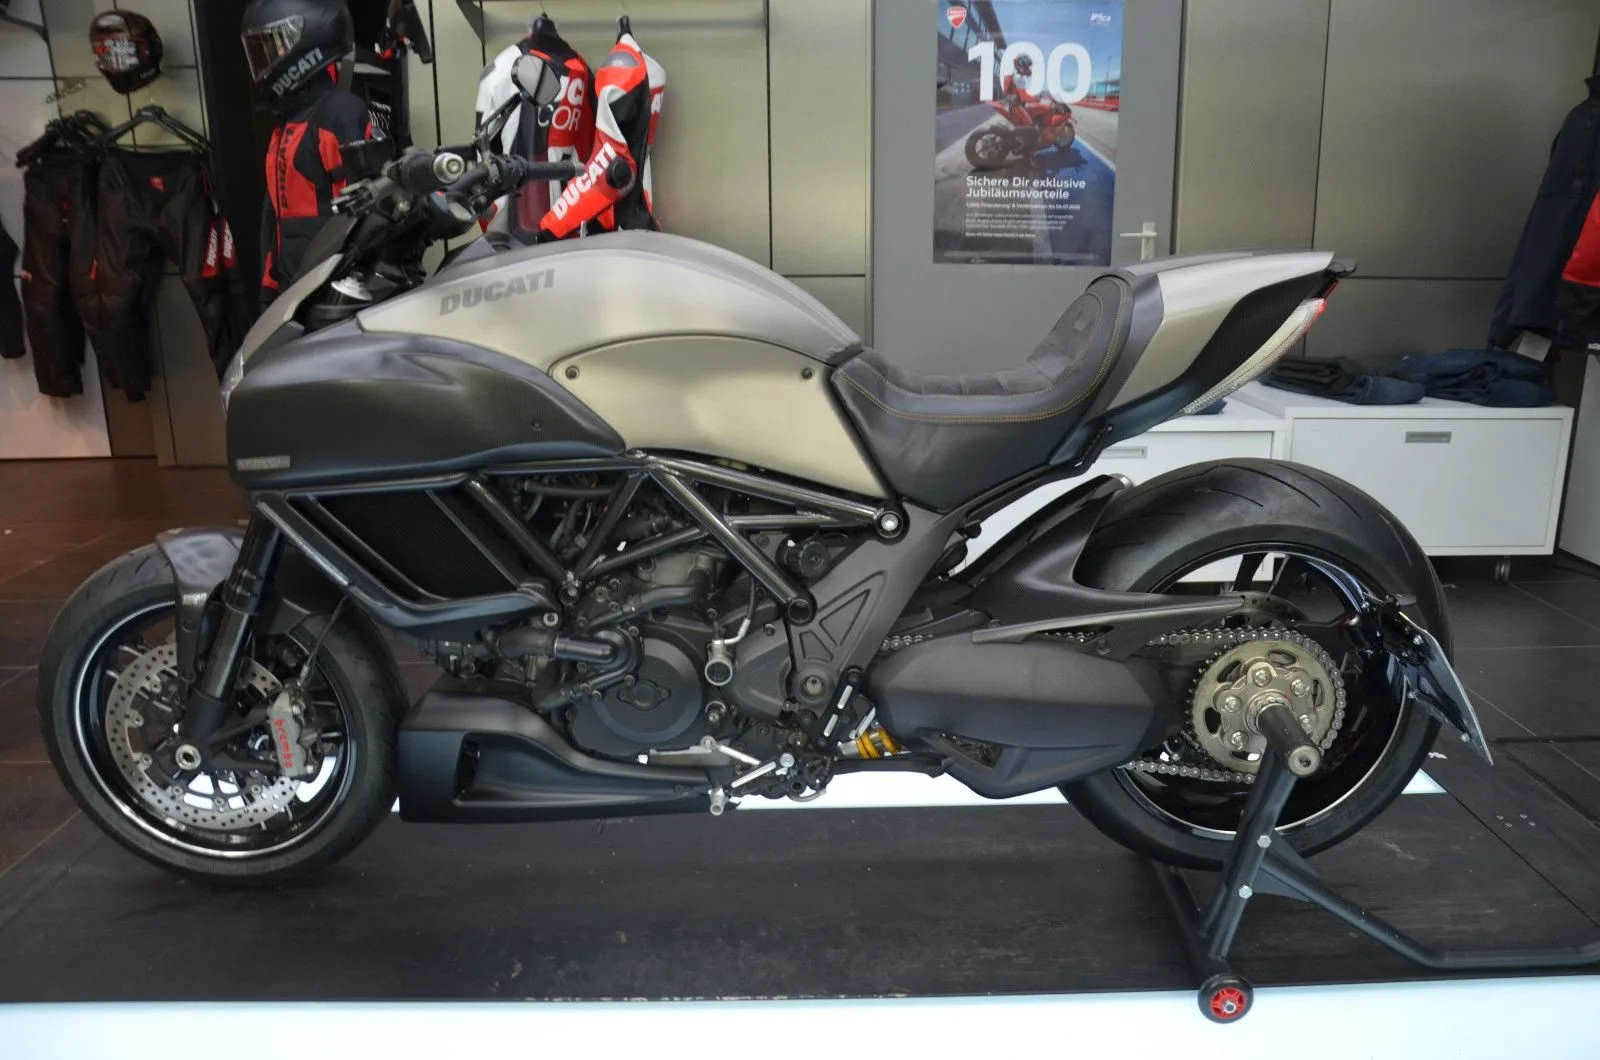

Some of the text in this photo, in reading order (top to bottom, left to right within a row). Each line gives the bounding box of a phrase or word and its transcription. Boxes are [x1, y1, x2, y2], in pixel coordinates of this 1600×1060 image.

[271, 46, 324, 96] DUCATI
[968, 41, 1092, 104] 100
[551, 141, 618, 221] DUCATI
[966, 175, 1087, 189] Sichere Dir exklusive
[966, 187, 1070, 200] Jubiläumsvorteile
[439, 268, 555, 316] DUCATI
[275, 719, 294, 768] brembo
